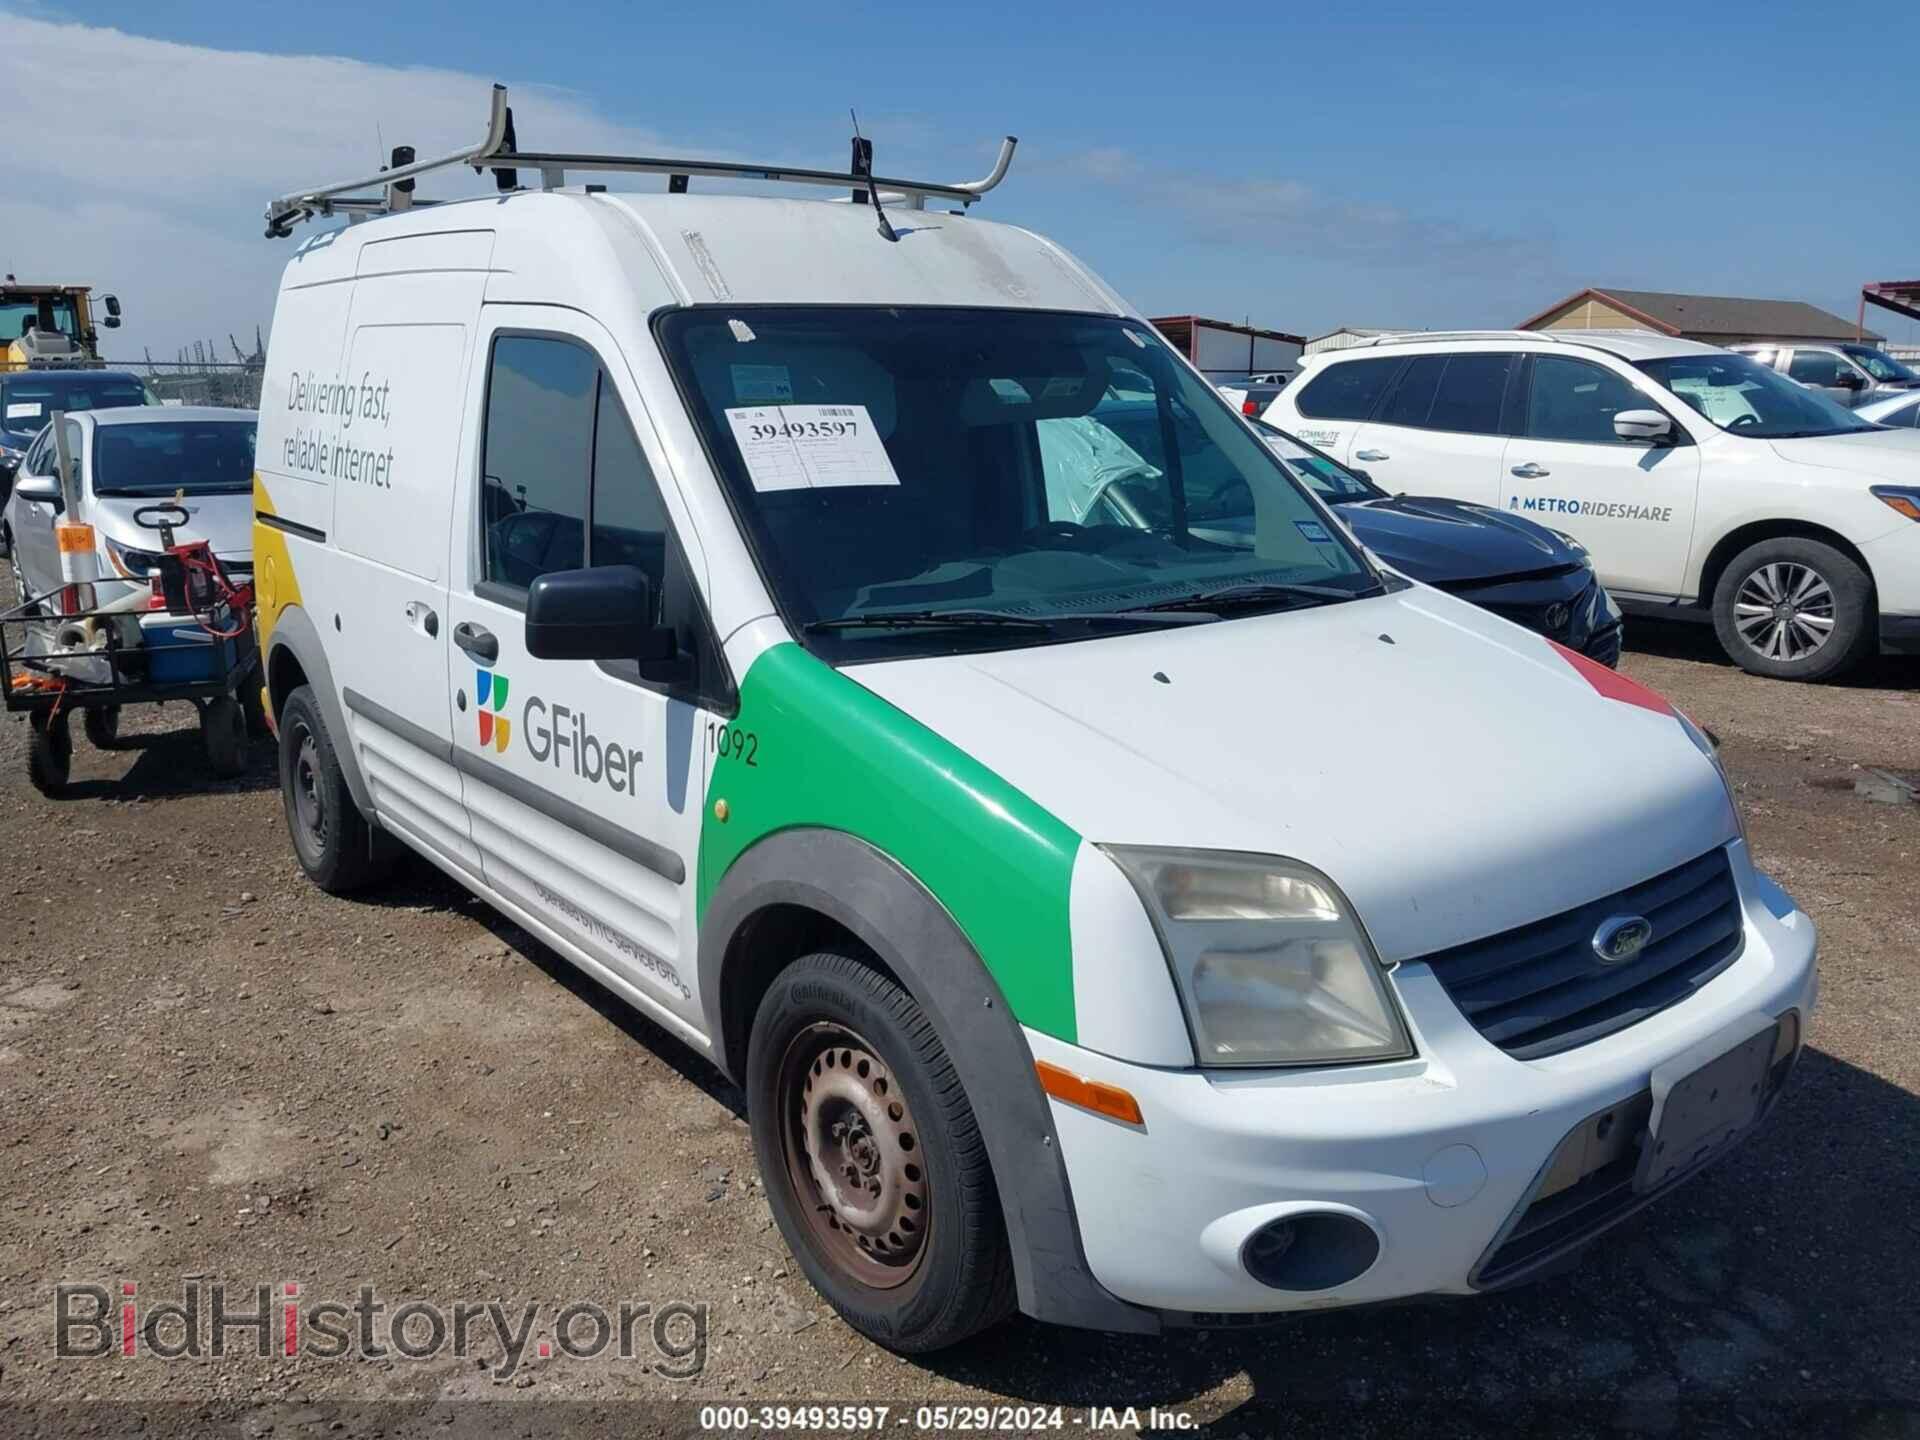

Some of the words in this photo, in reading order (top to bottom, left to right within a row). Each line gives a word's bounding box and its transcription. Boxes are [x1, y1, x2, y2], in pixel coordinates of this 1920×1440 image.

[287, 370, 356, 429] Delivering
[358, 371, 391, 429] fast,
[282, 426, 328, 475] reliable
[329, 434, 394, 490] internet
[749, 421, 857, 441] 39493597
[523, 695, 643, 797] GFiber
[707, 721, 758, 767] 1092
